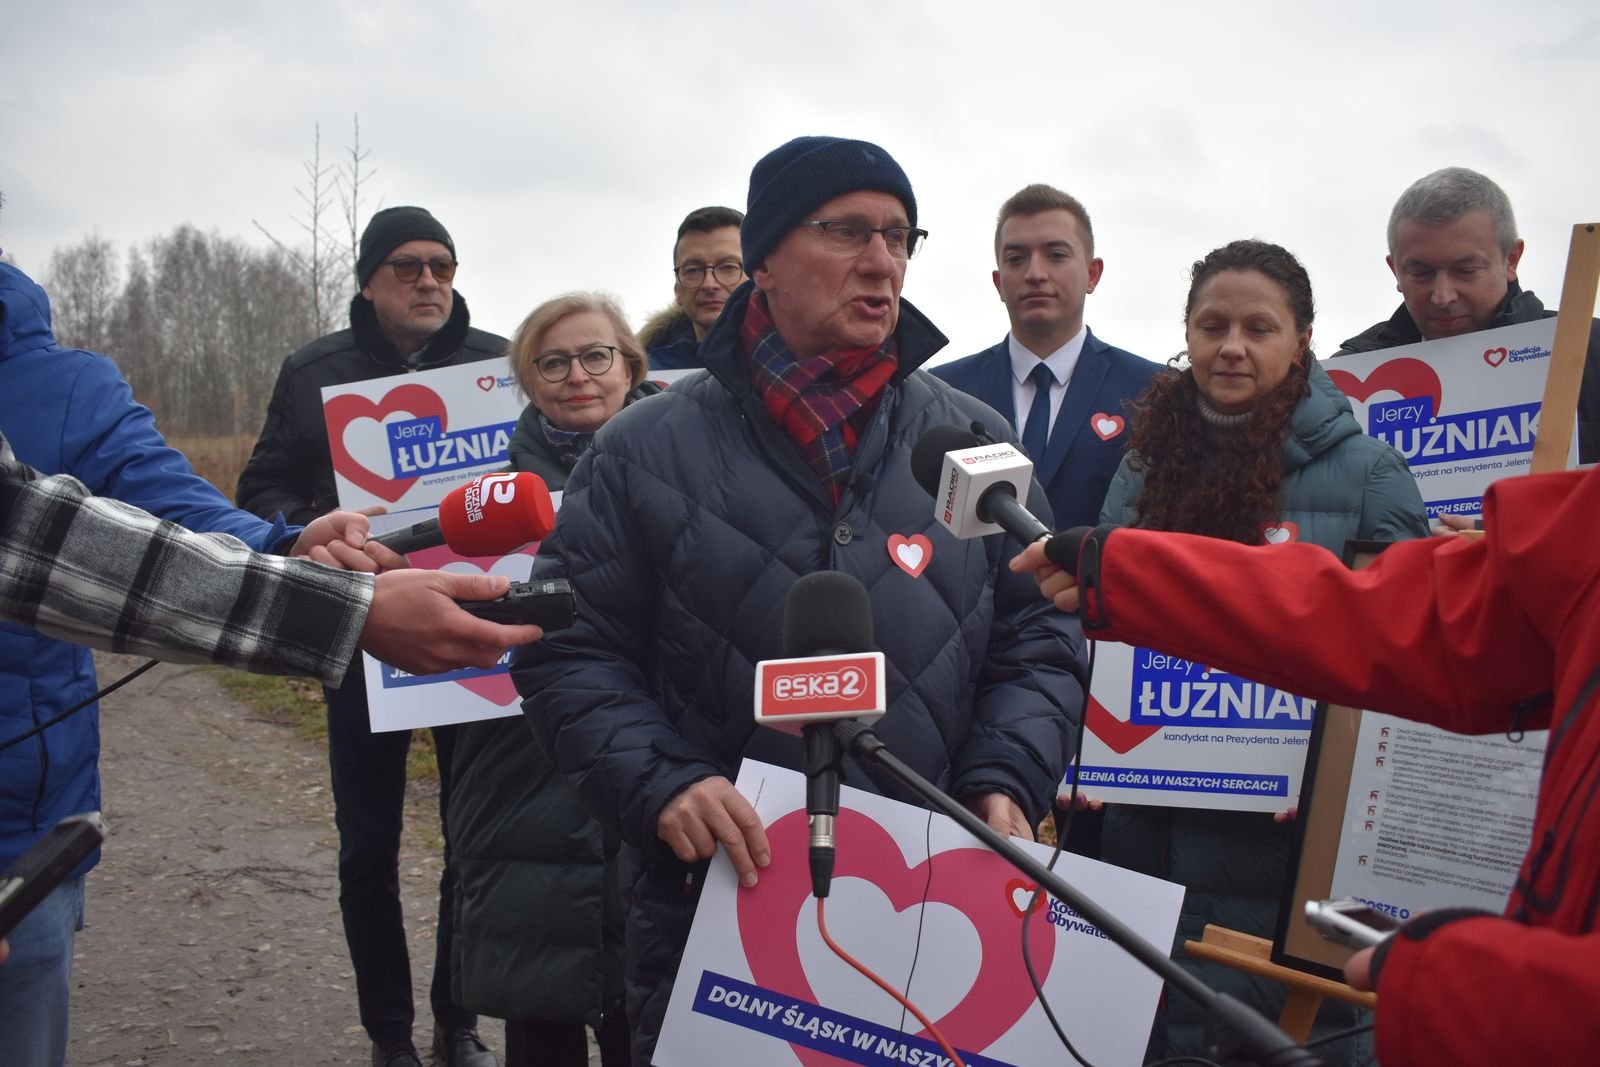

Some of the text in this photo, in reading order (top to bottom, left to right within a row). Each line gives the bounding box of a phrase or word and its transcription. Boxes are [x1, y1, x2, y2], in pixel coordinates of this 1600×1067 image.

[1376, 404, 1424, 423] Jerzy
[394, 422, 434, 440] Jerzy
[398, 427, 516, 472] ŁUŻNIA
[974, 450, 1014, 461] RADIO
[1454, 462, 1502, 474] Prezydenta
[946, 468, 957, 510] RADIO
[465, 487, 476, 522] RADIO
[1453, 502, 1484, 512] SERC
[1142, 652, 1194, 676] Jerzy
[776, 671, 860, 698] eska2
[1164, 732, 1208, 743] kandydat
[1226, 734, 1280, 746] Prezydenta
[1117, 770, 1150, 784] GÓRA
[1152, 776, 1165, 784] W
[1166, 776, 1220, 788] NASZYCH
[1222, 779, 1279, 791] SERCACH
[708, 985, 972, 1066] DOLNY ŚLĄSK W NASZY
